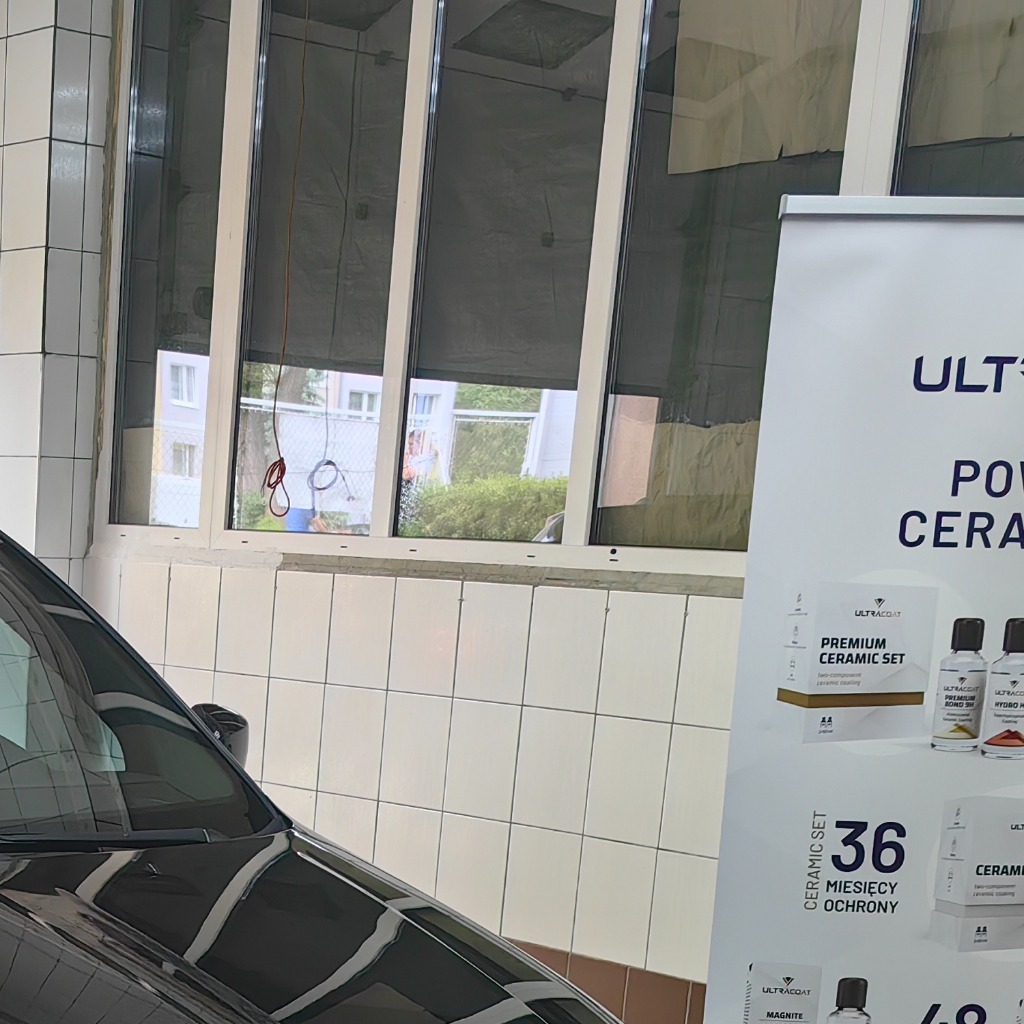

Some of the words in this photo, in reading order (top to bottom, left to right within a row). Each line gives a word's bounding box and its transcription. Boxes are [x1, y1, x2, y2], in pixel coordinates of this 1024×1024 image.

[913, 355, 1024, 393] ULT
[951, 459, 1024, 498] PO
[898, 510, 1024, 550] CERA
[854, 610, 902, 618] ULTRACOAT
[820, 637, 887, 650] PREMIUM
[819, 652, 880, 665] CERAMIC
[882, 653, 906, 665] SET
[811, 810, 827, 840] SET
[831, 820, 907, 873] 36
[804, 843, 824, 910] CERAMIC
[825, 880, 898, 897] MIESIĘCY
[823, 899, 899, 914] OCHRONY
[762, 987, 811, 996] ULTRACOAT
[766, 1011, 804, 1020] MAGNITE
